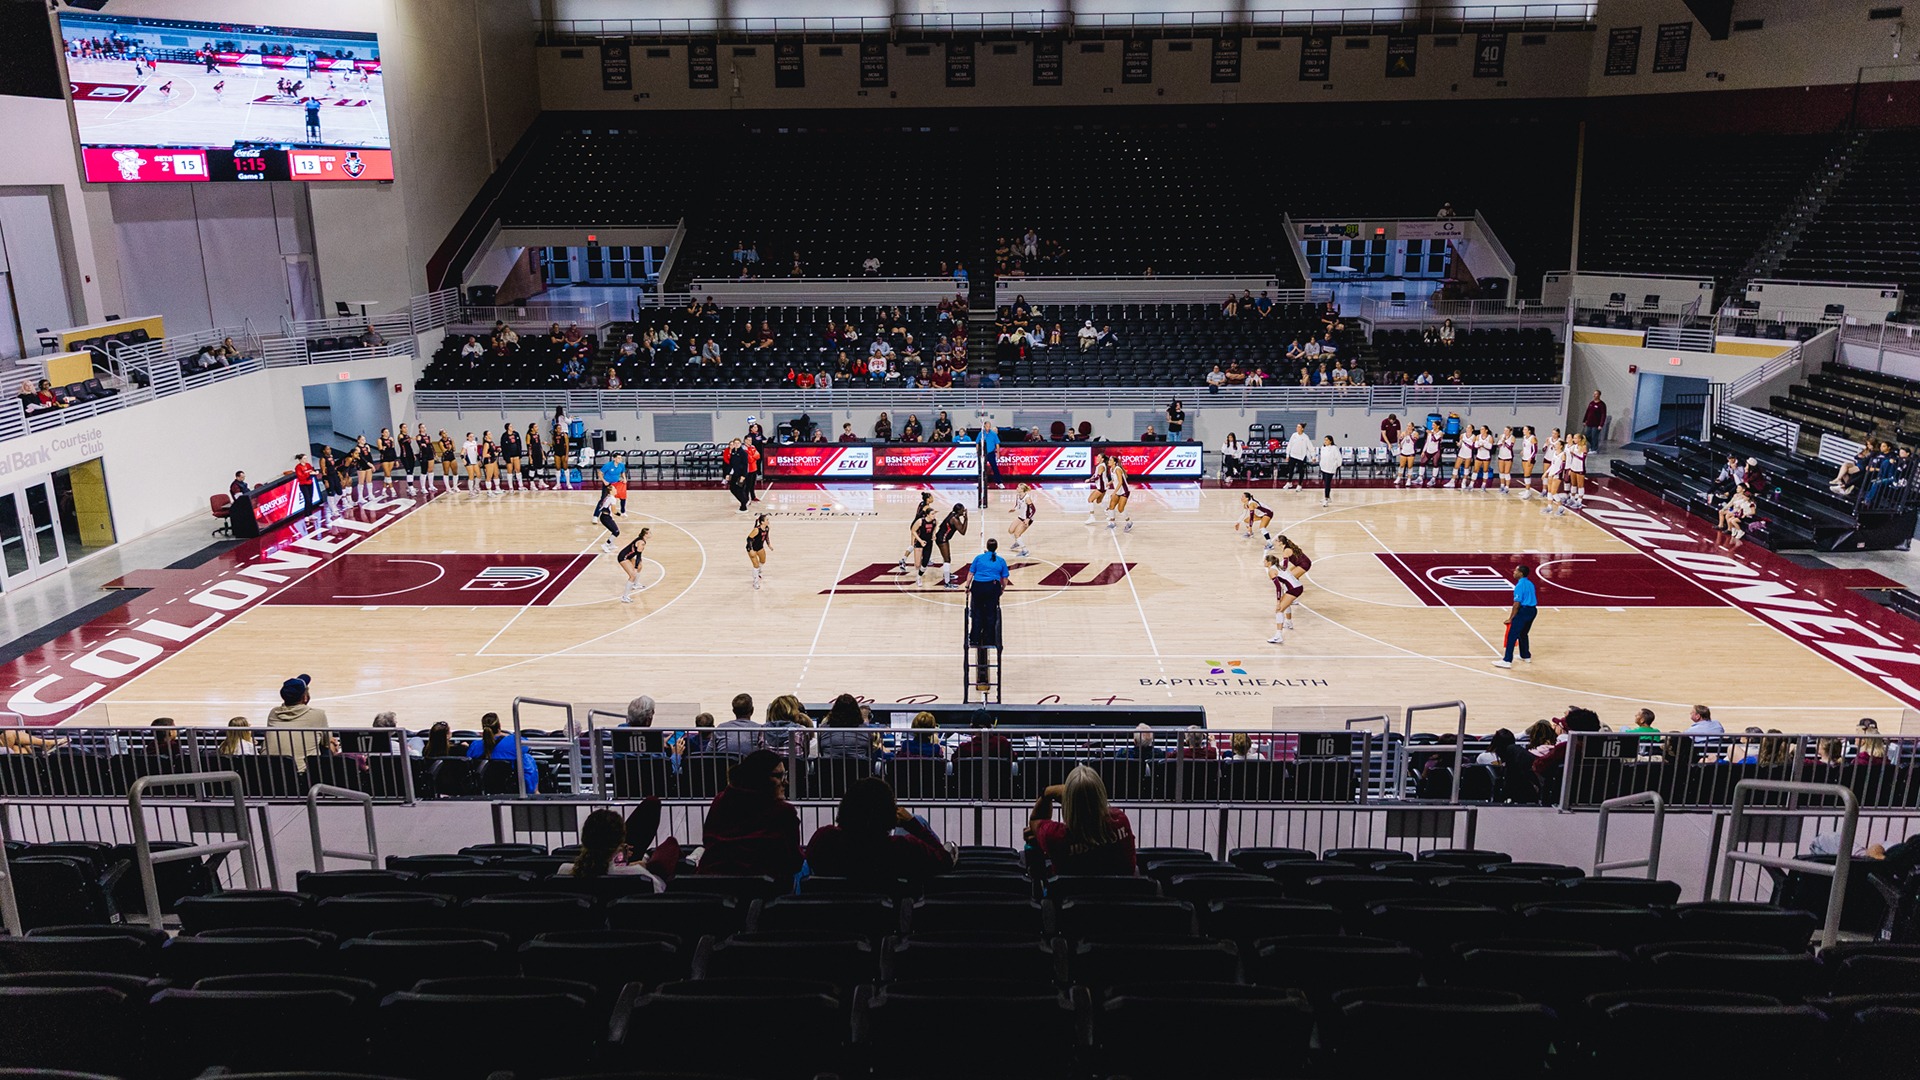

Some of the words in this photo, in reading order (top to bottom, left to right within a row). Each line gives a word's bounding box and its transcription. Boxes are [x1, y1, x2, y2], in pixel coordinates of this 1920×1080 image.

[1481, 46, 1500, 61] 40
[162, 162, 170, 172] 2
[181, 161, 195, 170] 15
[233, 158, 266, 171] 1:15
[302, 161, 314, 170] 13
[325, 162, 333, 172] 0
[238, 173, 259, 181] Game
[51, 428, 102, 452] Courtside
[80, 442, 104, 456] Club
[12, 445, 51, 471] Bank
[838, 460, 868, 468] EKU
[946, 460, 977, 468] EKU
[1056, 460, 1087, 468] EKU
[1166, 460, 1197, 468] EKU
[7, 497, 417, 717] COLONELS
[1140, 678, 1230, 686] BAPTIST
[1238, 679, 1329, 687] HEALTH
[357, 736, 373, 752] 117
[629, 736, 647, 752] 116
[1317, 738, 1335, 755] 116
[1602, 741, 1621, 757] 115
[1117, 827, 1129, 840] IT.
